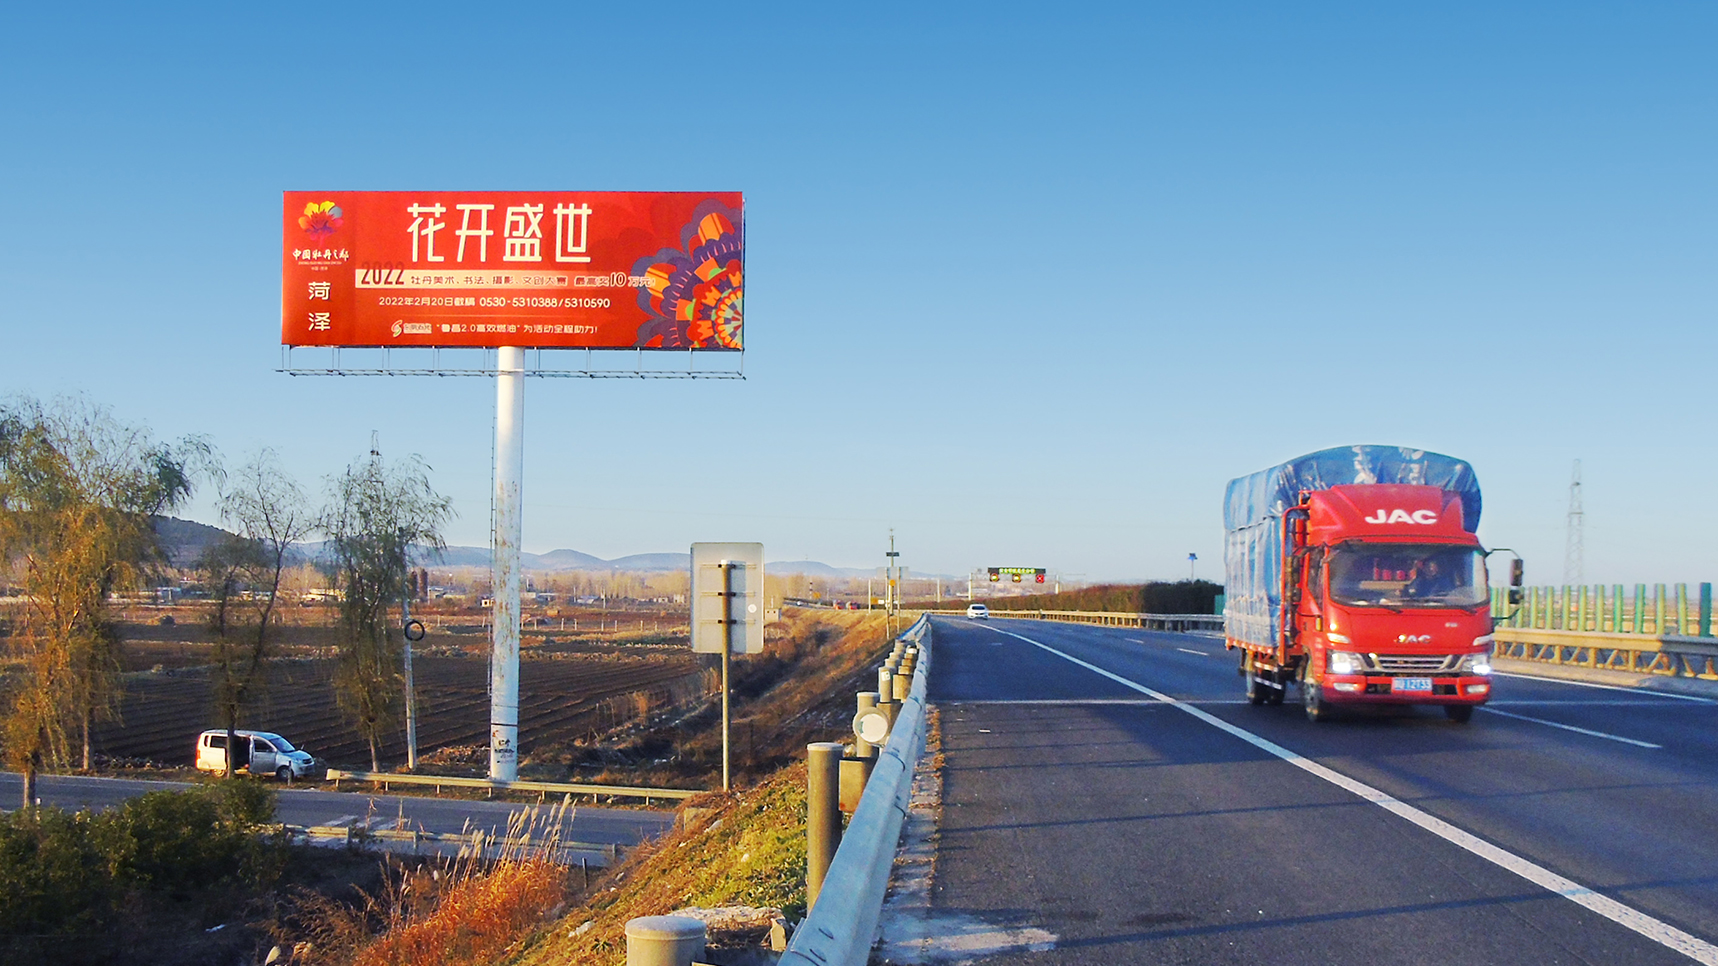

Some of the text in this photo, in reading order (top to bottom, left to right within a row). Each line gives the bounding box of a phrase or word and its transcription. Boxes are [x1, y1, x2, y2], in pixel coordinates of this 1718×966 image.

[407, 203, 592, 263] 花开盛世
[292, 248, 350, 261] 中国牡丹之都
[361, 260, 405, 285] 2022
[308, 281, 331, 331] 菏泽
[479, 296, 611, 308] 0530-5310388/5310590
[1365, 509, 1438, 525] JAC
[1395, 634, 1431, 644] JAC
